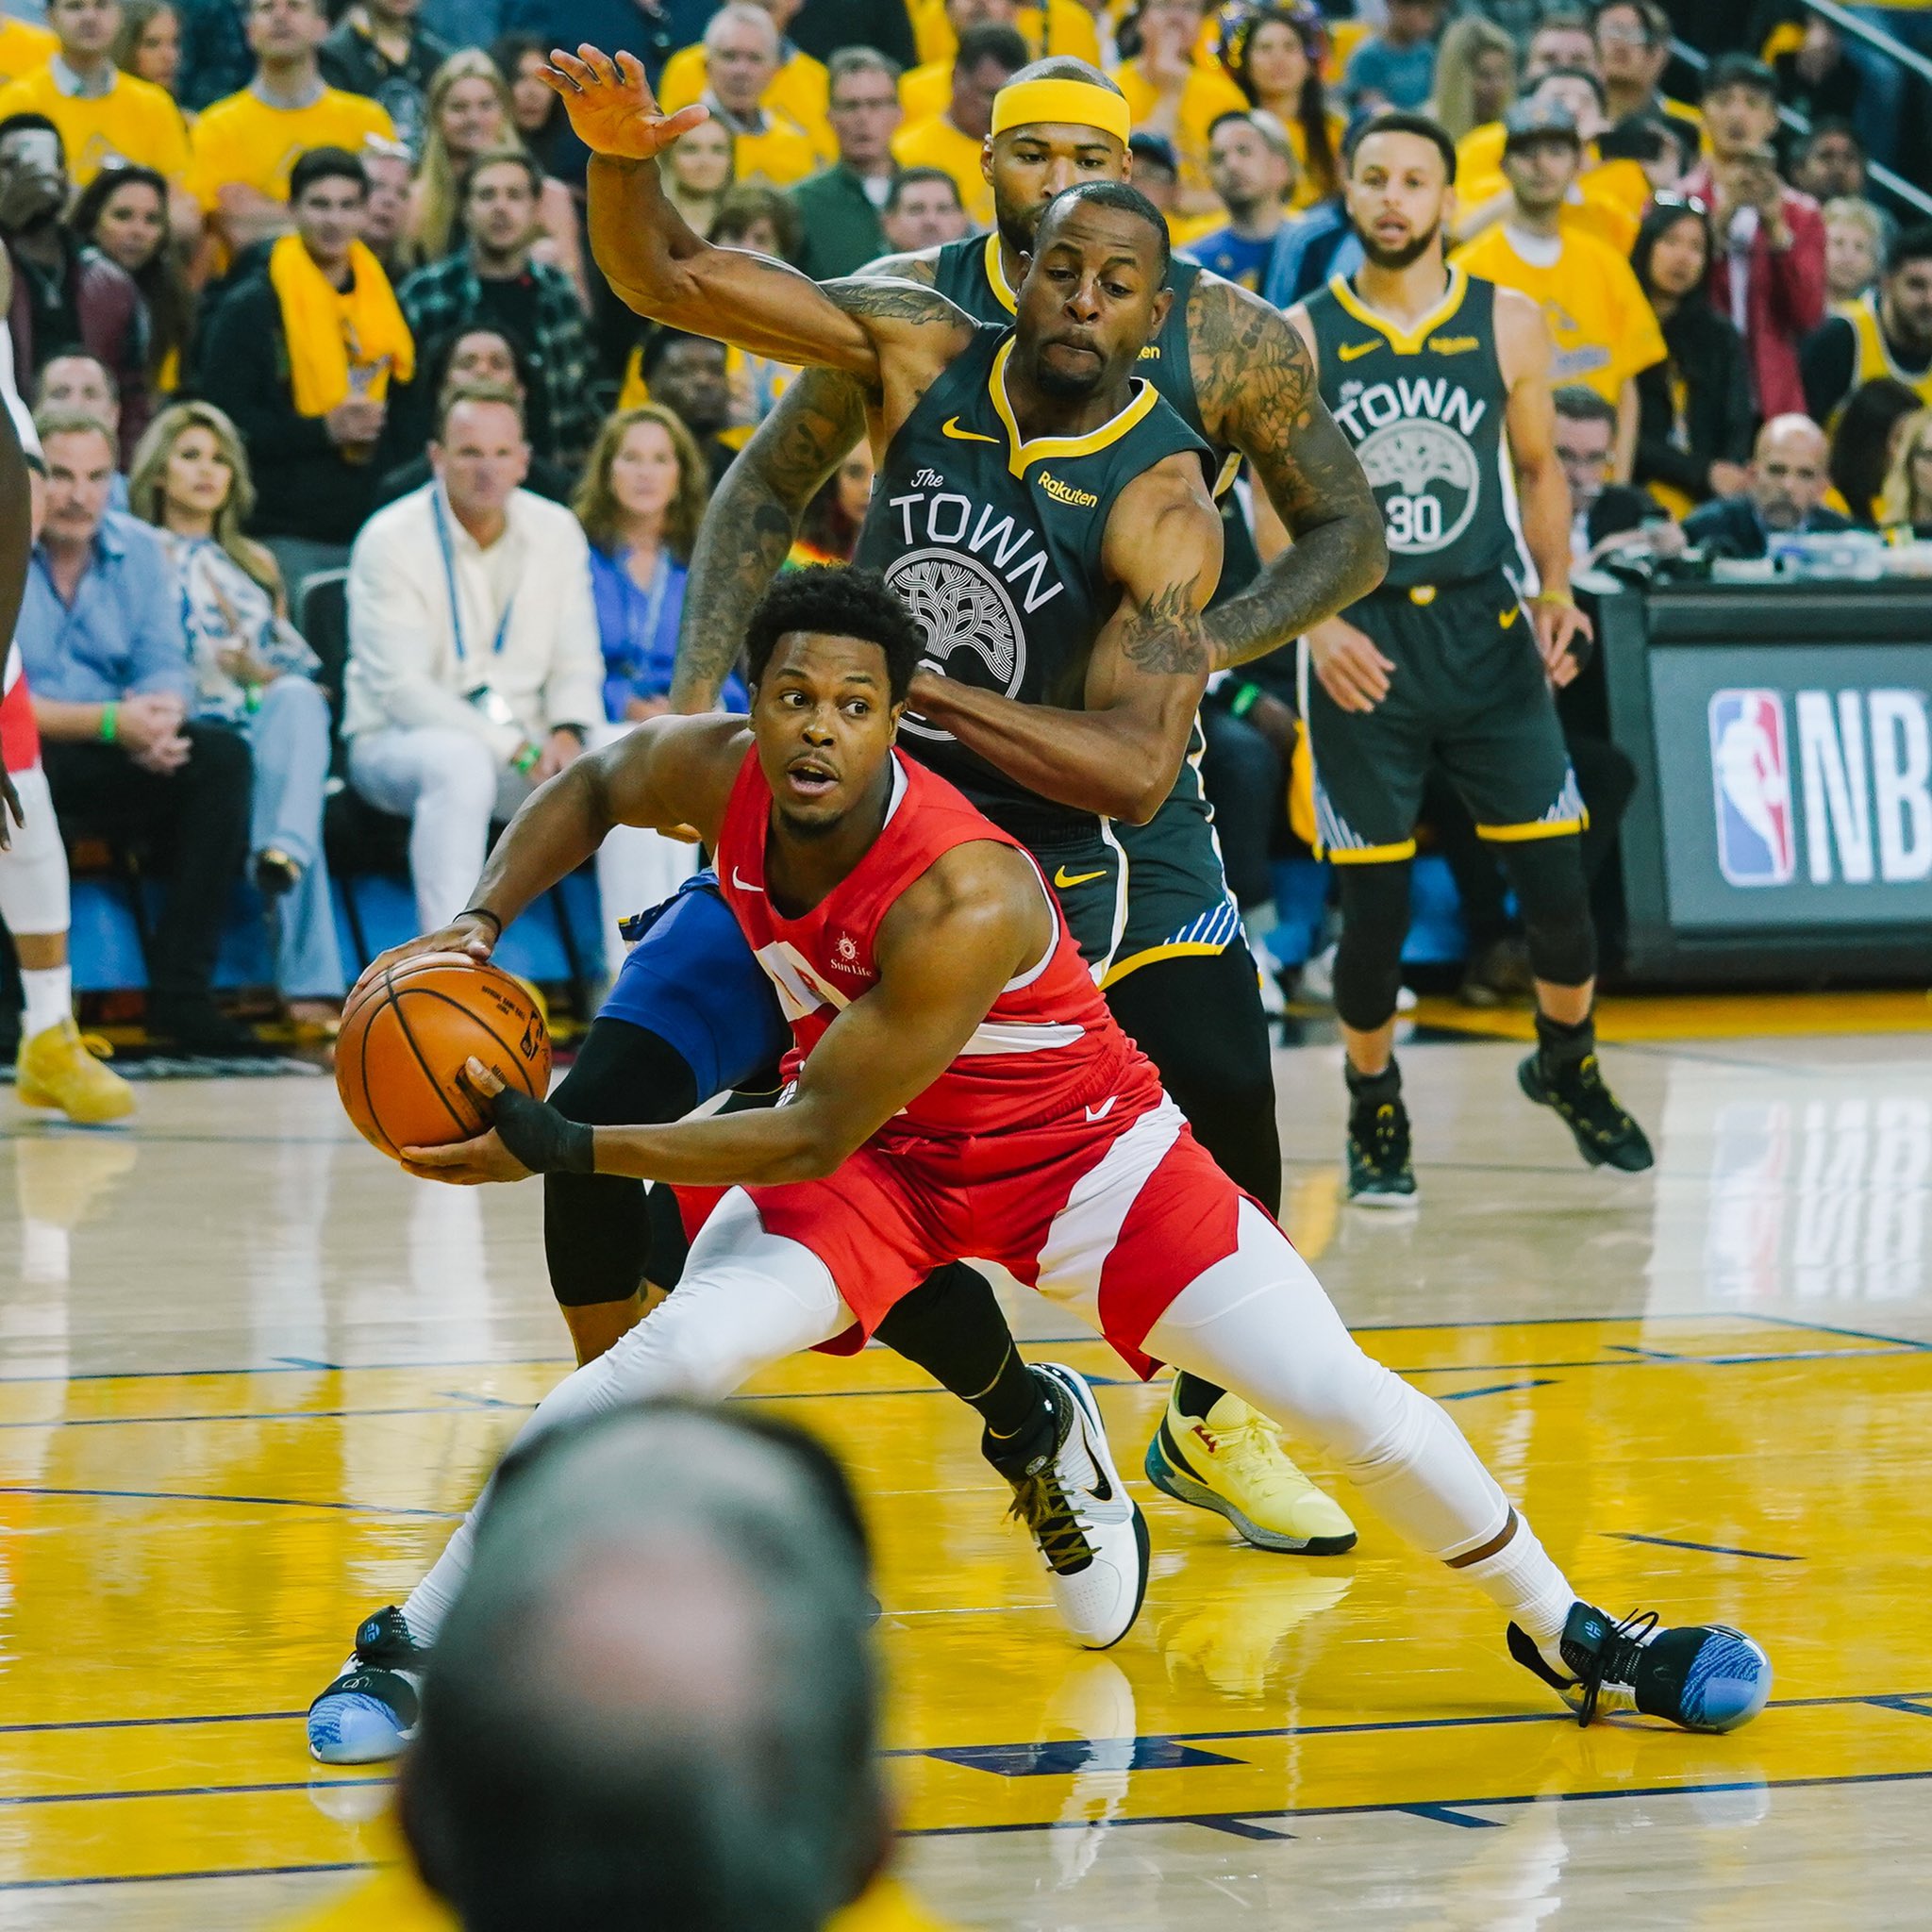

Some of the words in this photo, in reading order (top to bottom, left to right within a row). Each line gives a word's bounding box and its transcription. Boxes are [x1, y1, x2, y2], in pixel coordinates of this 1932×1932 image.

[1333, 377, 1486, 440] TOWN
[910, 469, 943, 488] The
[1038, 471, 1098, 508] Rakuten
[1385, 495, 1441, 544] 30
[890, 492, 1064, 614] TOWN
[830, 958, 851, 973] Sun
[852, 965, 873, 976] Life
